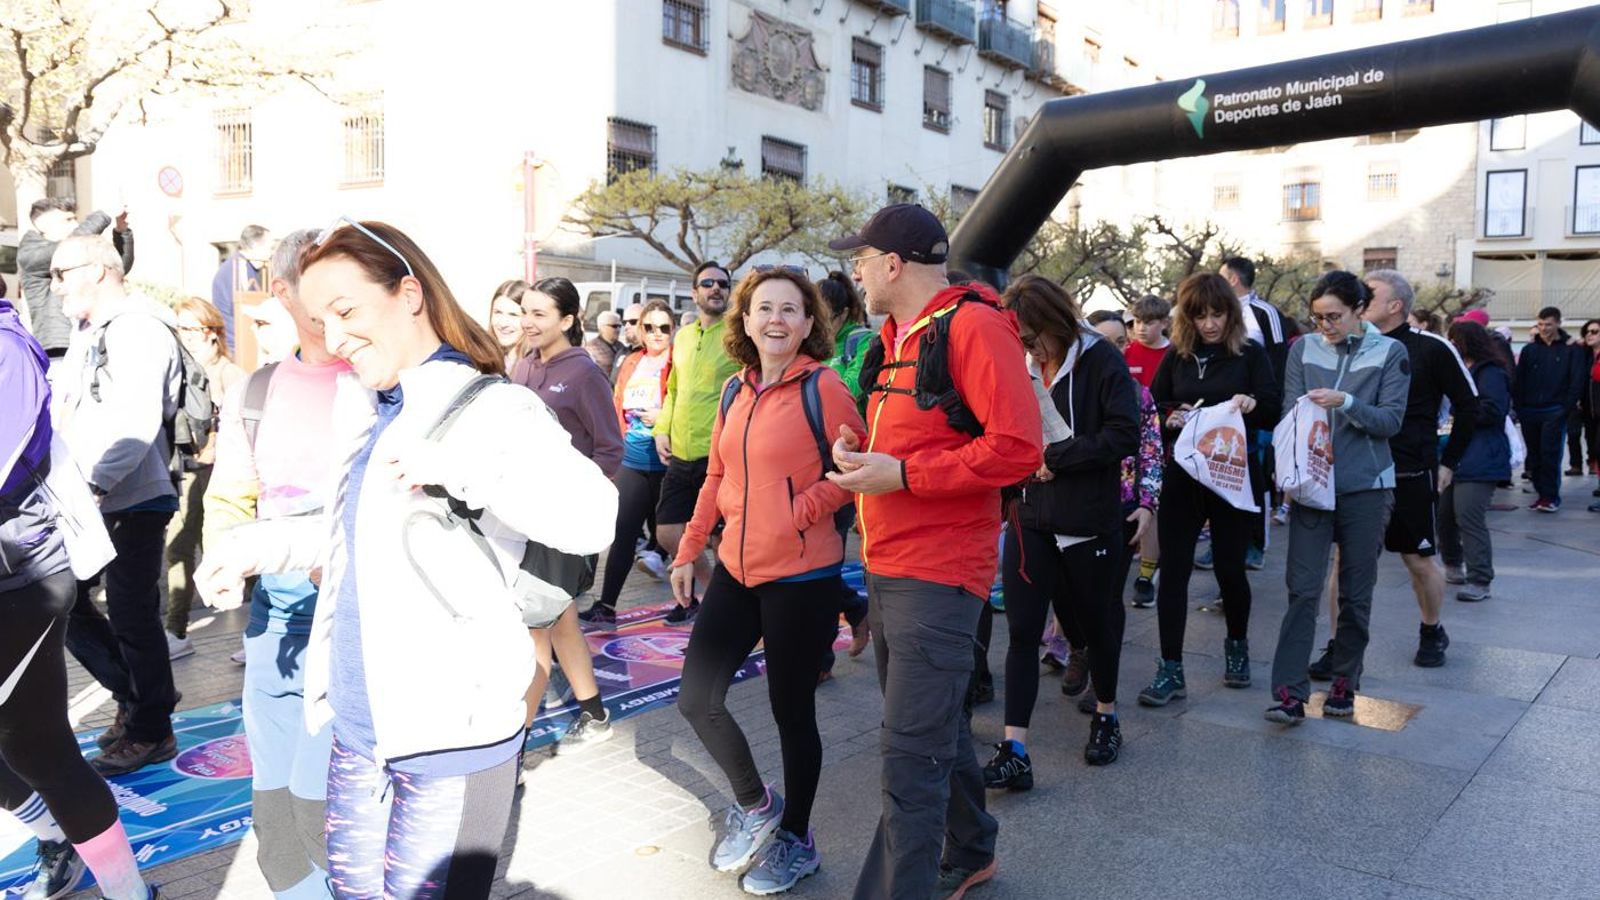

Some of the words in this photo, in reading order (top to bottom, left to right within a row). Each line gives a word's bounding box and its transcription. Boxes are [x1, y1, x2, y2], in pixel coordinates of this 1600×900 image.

[1214, 86, 1282, 108] Patronato
[1285, 72, 1359, 96] Municipal
[1363, 69, 1384, 84] de
[1214, 102, 1279, 124] Deportes
[1282, 99, 1302, 113] de
[1305, 92, 1342, 111] Jaén
